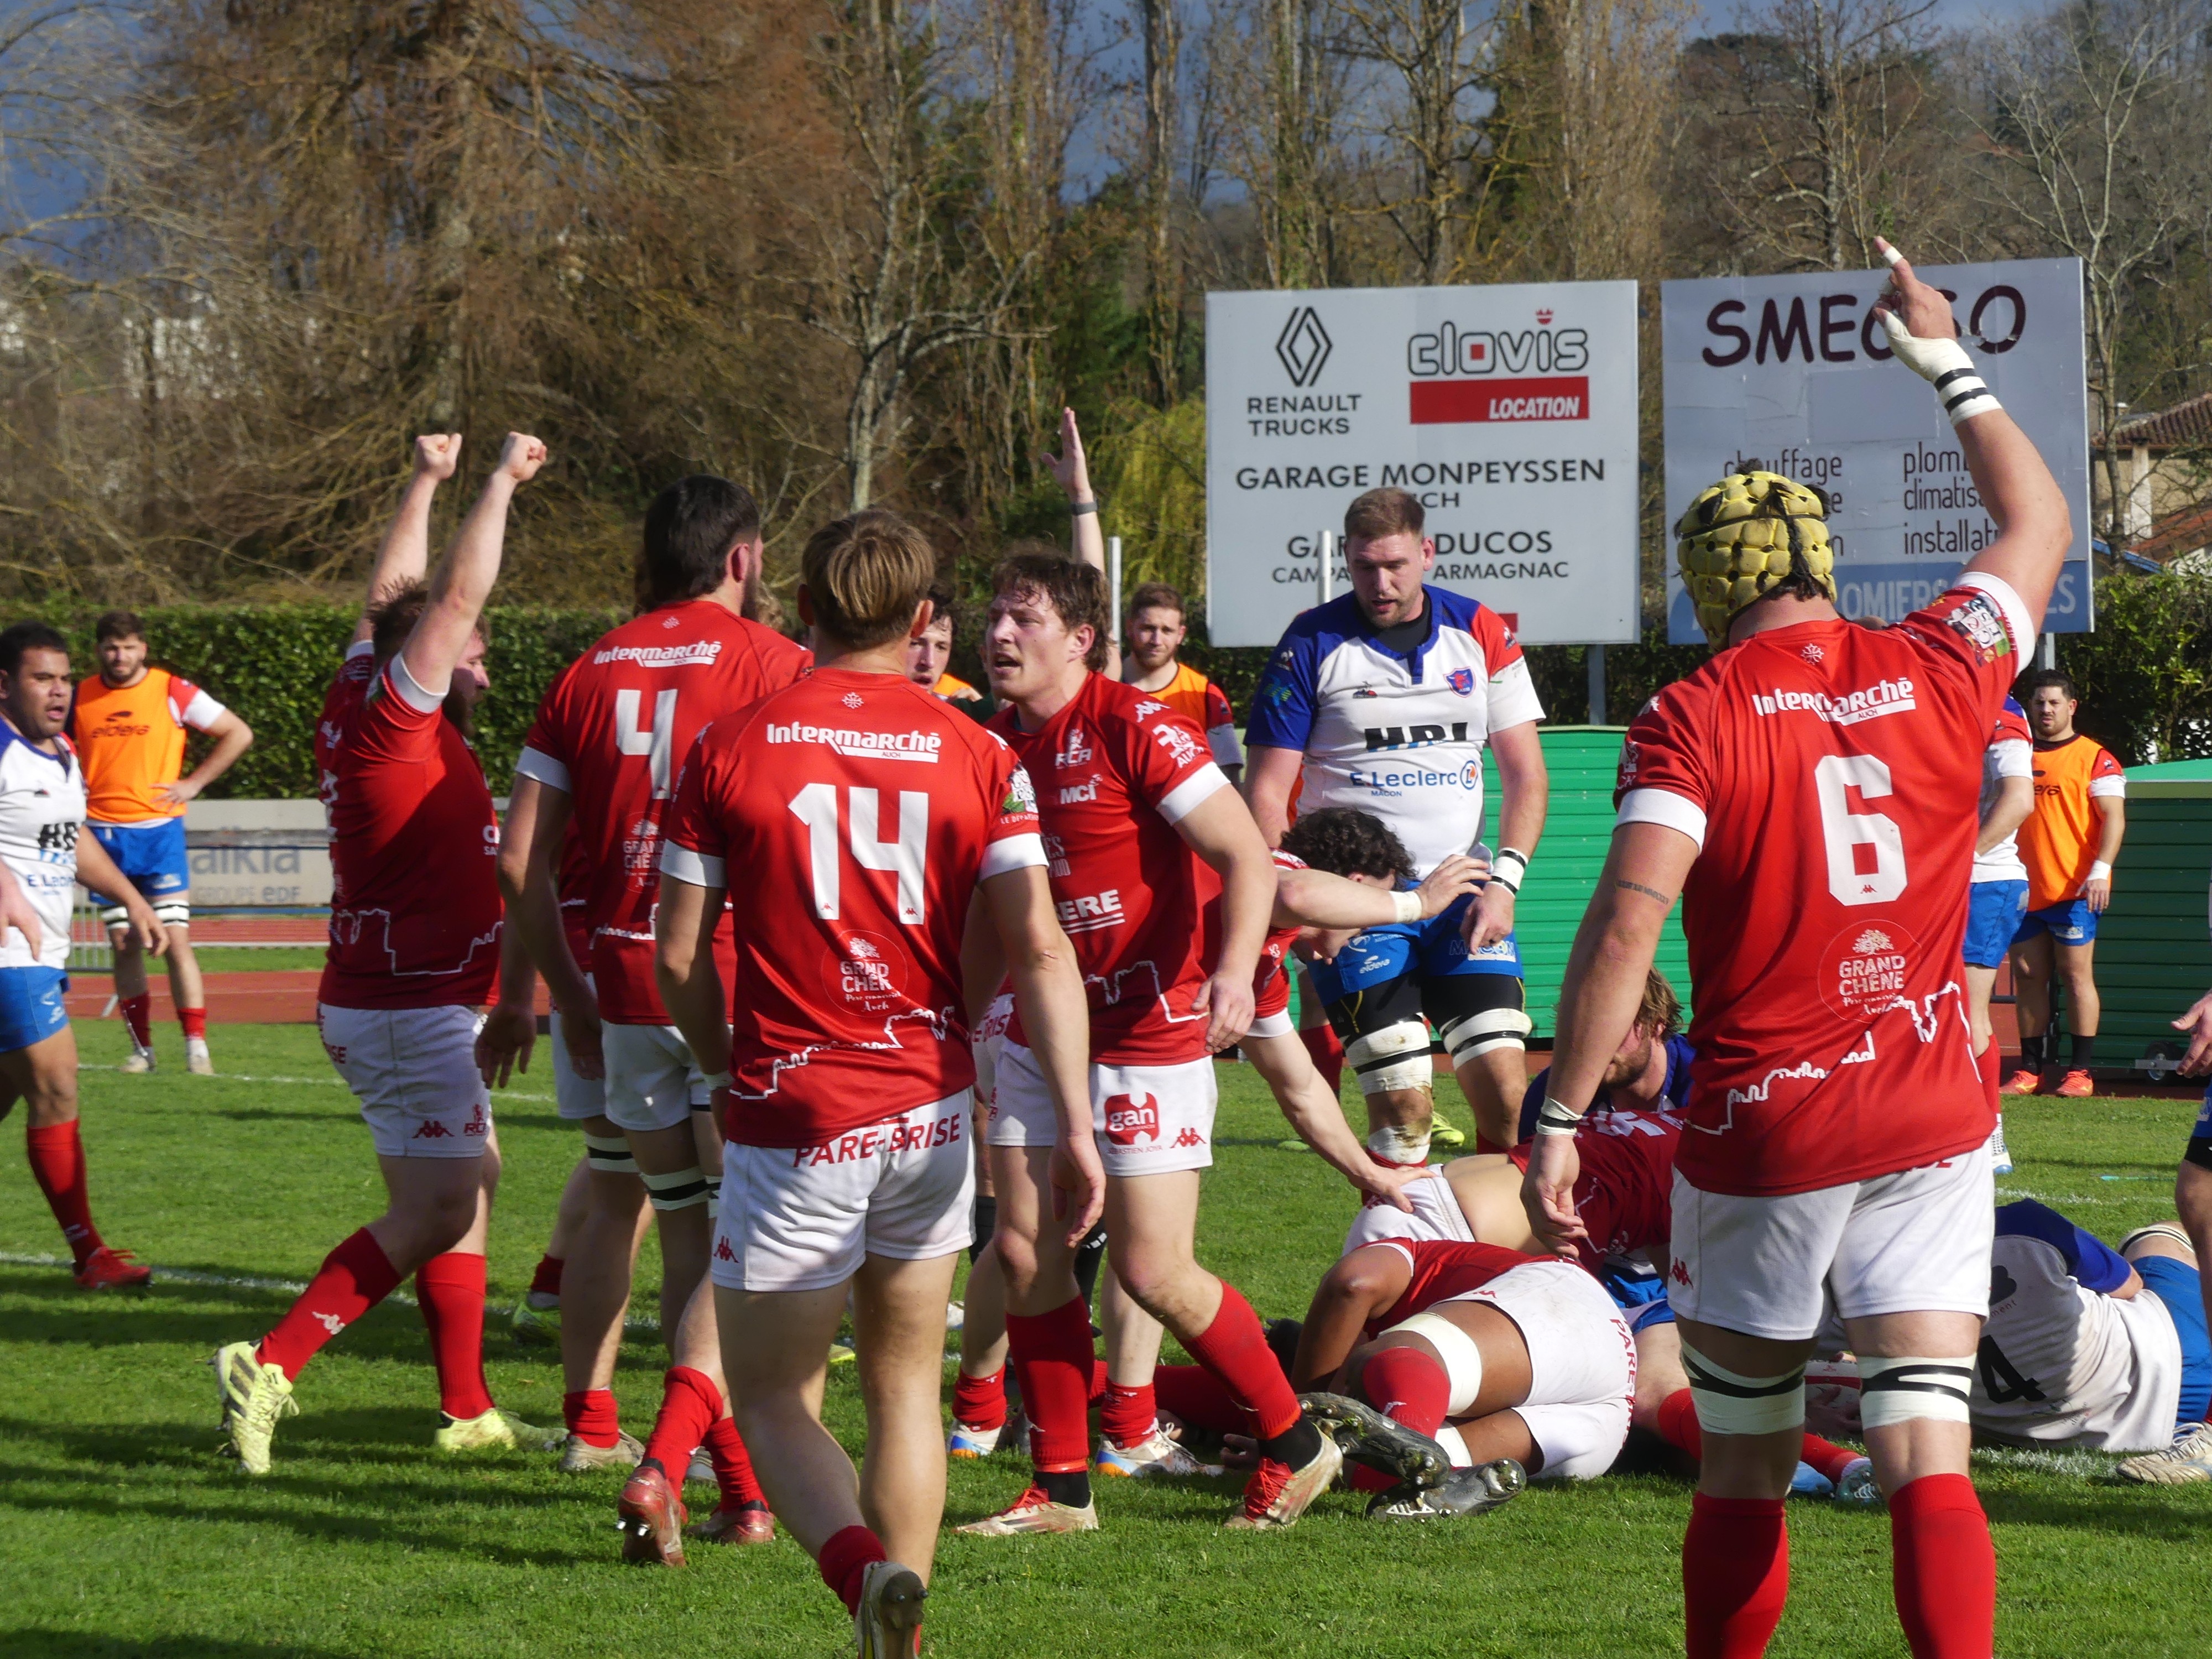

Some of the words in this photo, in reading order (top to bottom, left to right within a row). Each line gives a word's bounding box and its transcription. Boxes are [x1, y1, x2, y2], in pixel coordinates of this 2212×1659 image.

[1408, 319, 1589, 375] clovis
[1248, 394, 1362, 414] RENAULT
[1489, 397, 1580, 420] LOCATION
[1248, 418, 1350, 436] TRUCKS
[1235, 464, 1369, 490] GARAGE
[1380, 458, 1605, 487] MONPEYSSEN
[1434, 531, 1553, 555] DUCOS
[1432, 561, 1569, 581] ARMAGNAC
[593, 640, 722, 667] Intermarché
[615, 688, 678, 800] 4
[766, 721, 942, 755] Intermarché
[1350, 770, 1457, 787] E.Leclerc
[1814, 753, 1907, 906] 6
[788, 782, 929, 925] 14
[1839, 955, 1906, 978] GRAND
[1839, 971, 1905, 997] CHÊNE
[1109, 1108, 1156, 1132] gan
